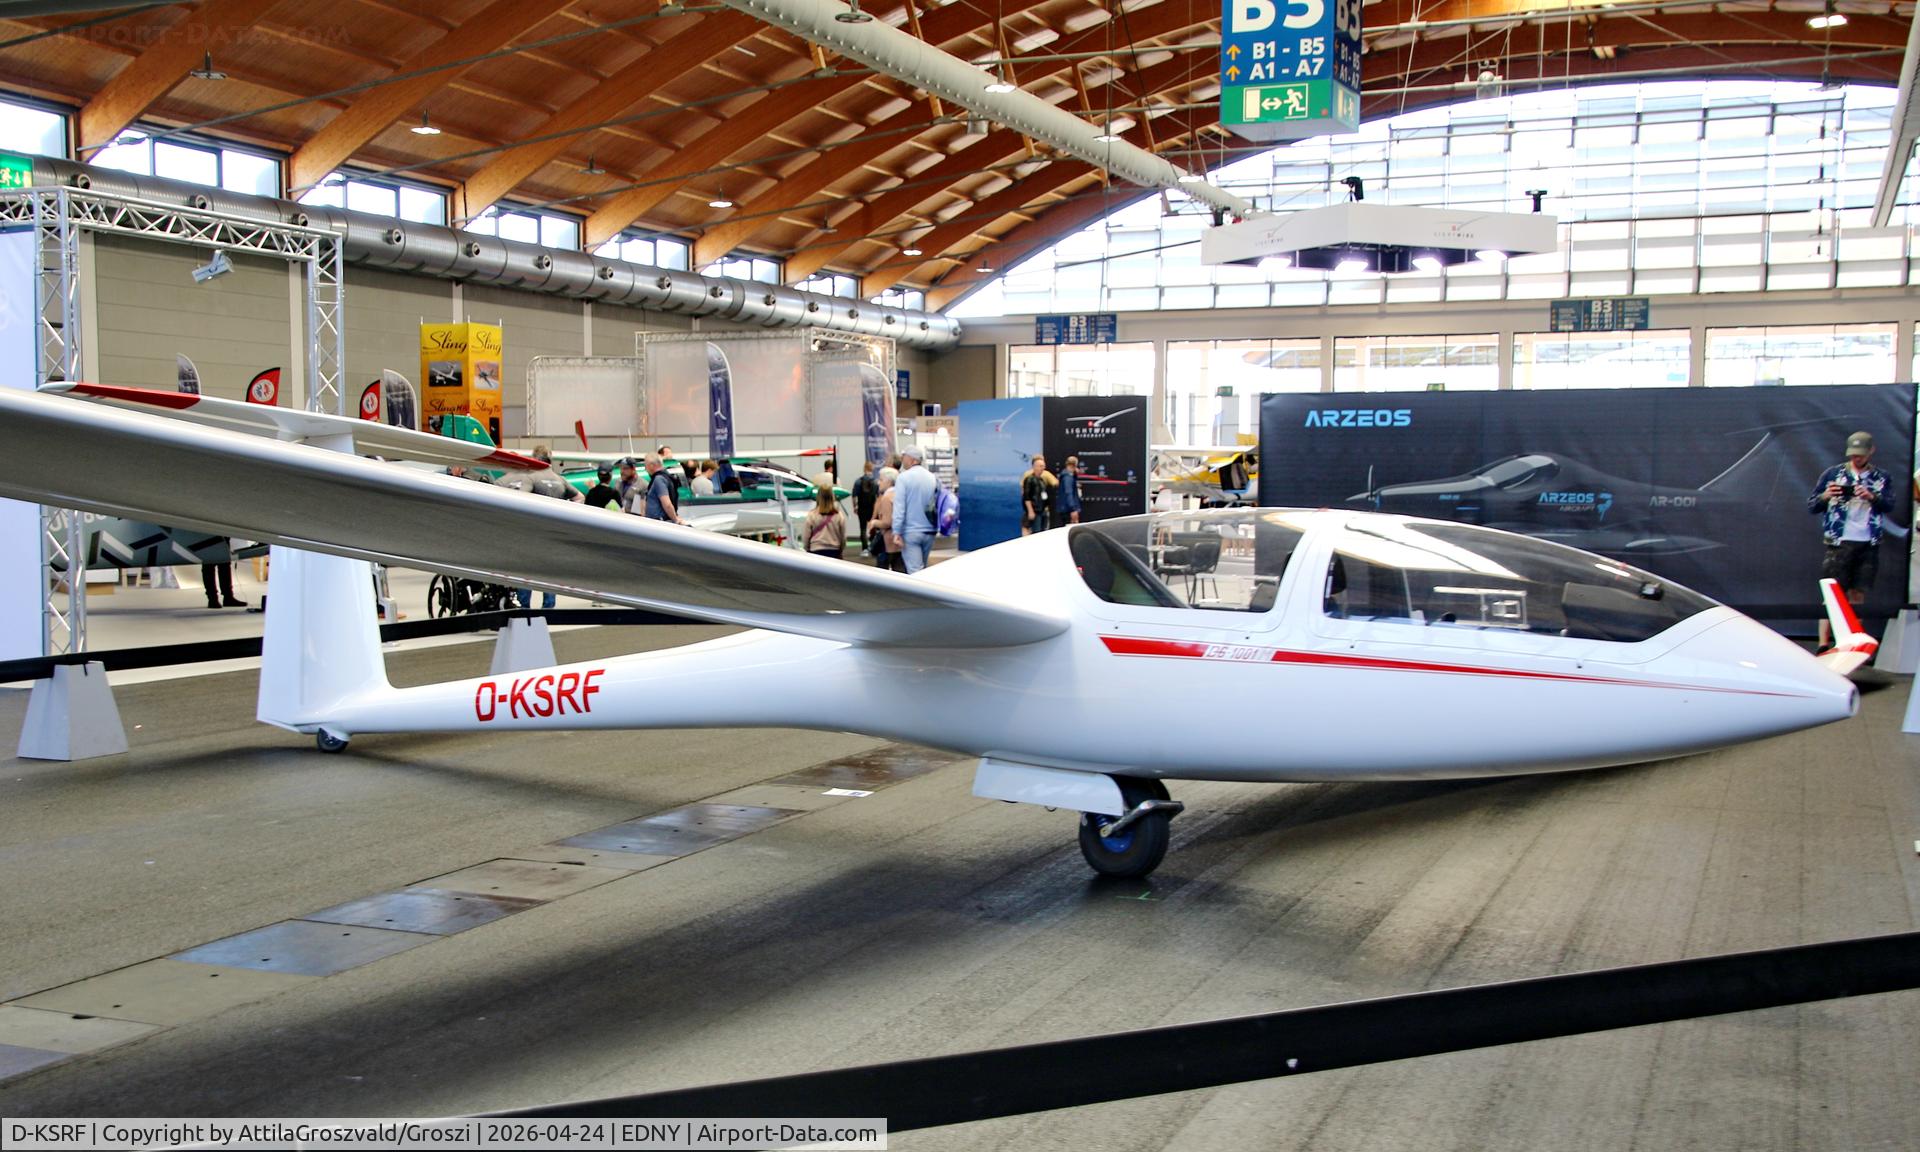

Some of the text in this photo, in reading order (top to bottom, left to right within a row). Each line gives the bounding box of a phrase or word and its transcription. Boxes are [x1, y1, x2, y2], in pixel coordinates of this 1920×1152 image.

[1252, 41, 1276, 60] B1
[1299, 37, 1325, 56] B5
[1249, 62, 1275, 81] A1
[1295, 57, 1325, 77] A7
[1592, 300, 1612, 313] B3
[1069, 315, 1087, 328] B3
[423, 330, 468, 354] Sling
[471, 331, 502, 356] Sling
[1304, 409, 1411, 427] ARZEOS
[1538, 492, 1595, 503] ARZEOS
[475, 669, 606, 722] D-KSRF
